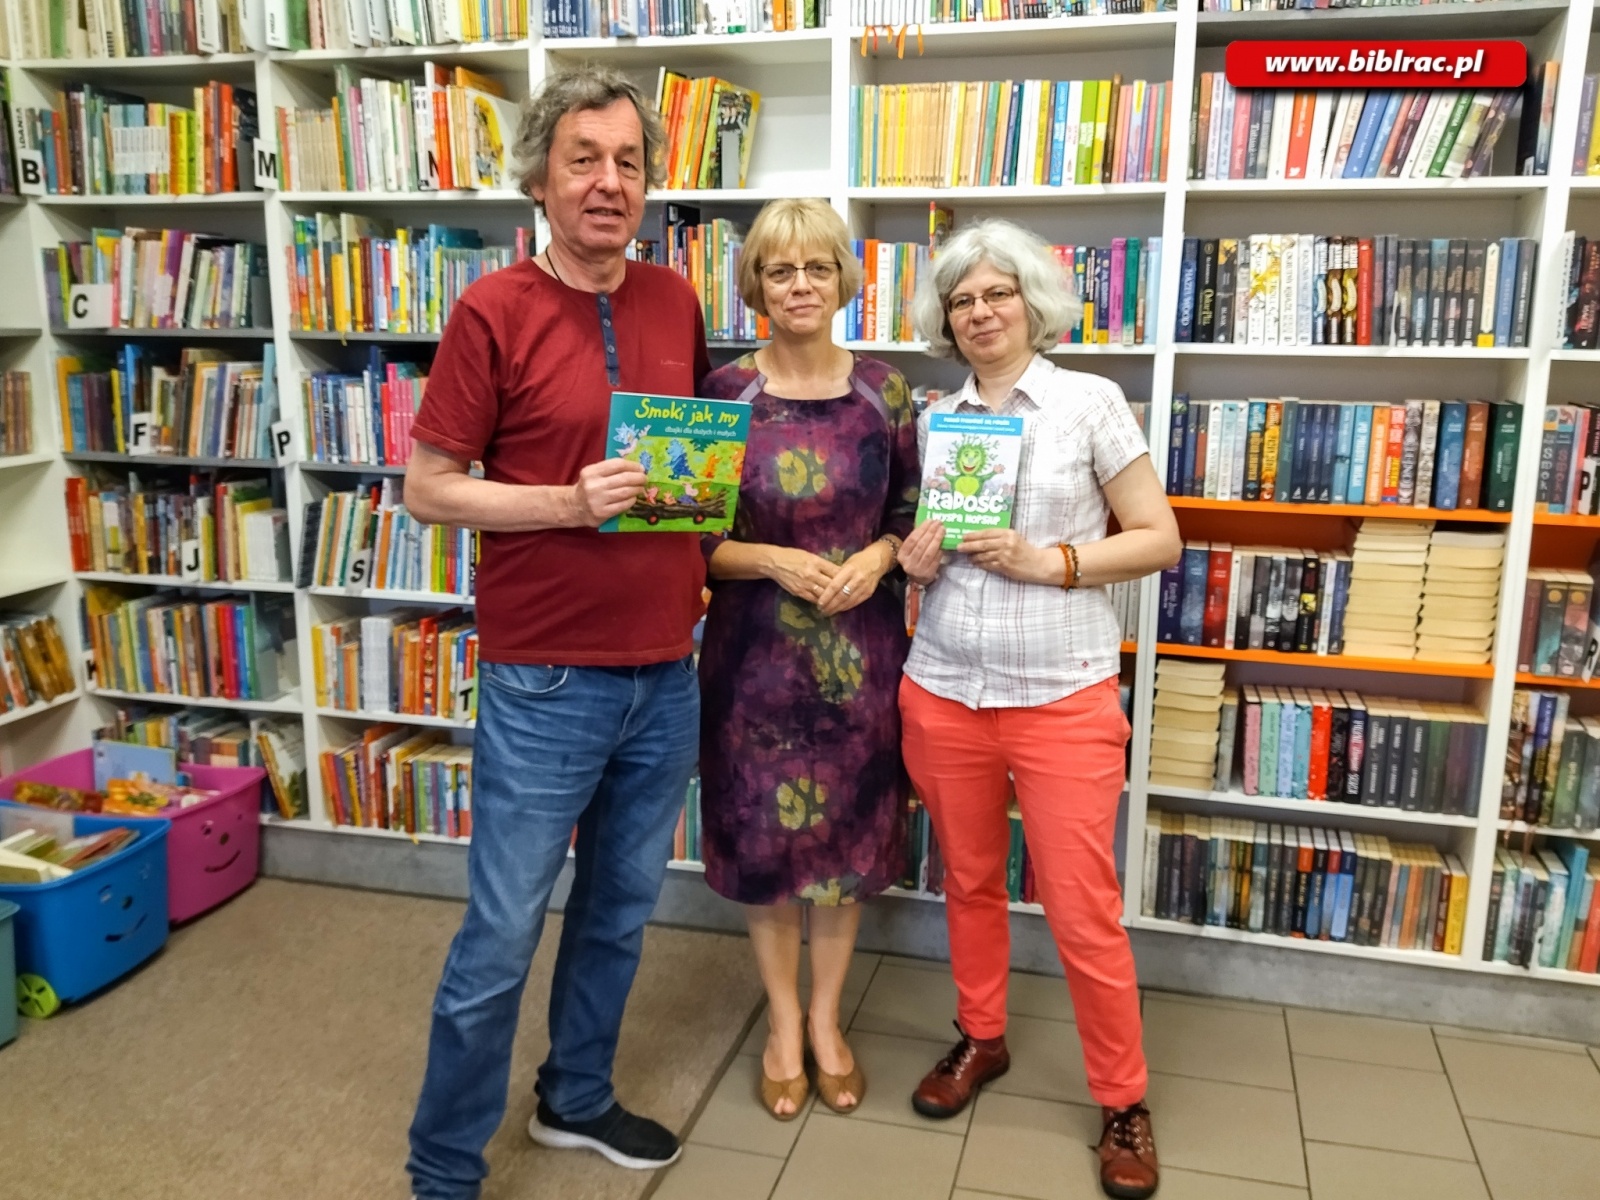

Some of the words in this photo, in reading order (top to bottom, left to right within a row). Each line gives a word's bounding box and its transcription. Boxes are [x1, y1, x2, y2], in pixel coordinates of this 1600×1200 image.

[21, 158, 40, 184] B
[258, 150, 277, 178] M
[73, 293, 89, 319] C
[1181, 297, 1192, 326] WOOD
[635, 398, 687, 422] Smoki
[688, 403, 713, 427] jak
[718, 412, 739, 427] my
[133, 422, 147, 445] F
[276, 430, 291, 456] P
[186, 547, 200, 572] J
[350, 559, 366, 583] S
[460, 686, 473, 711] T
